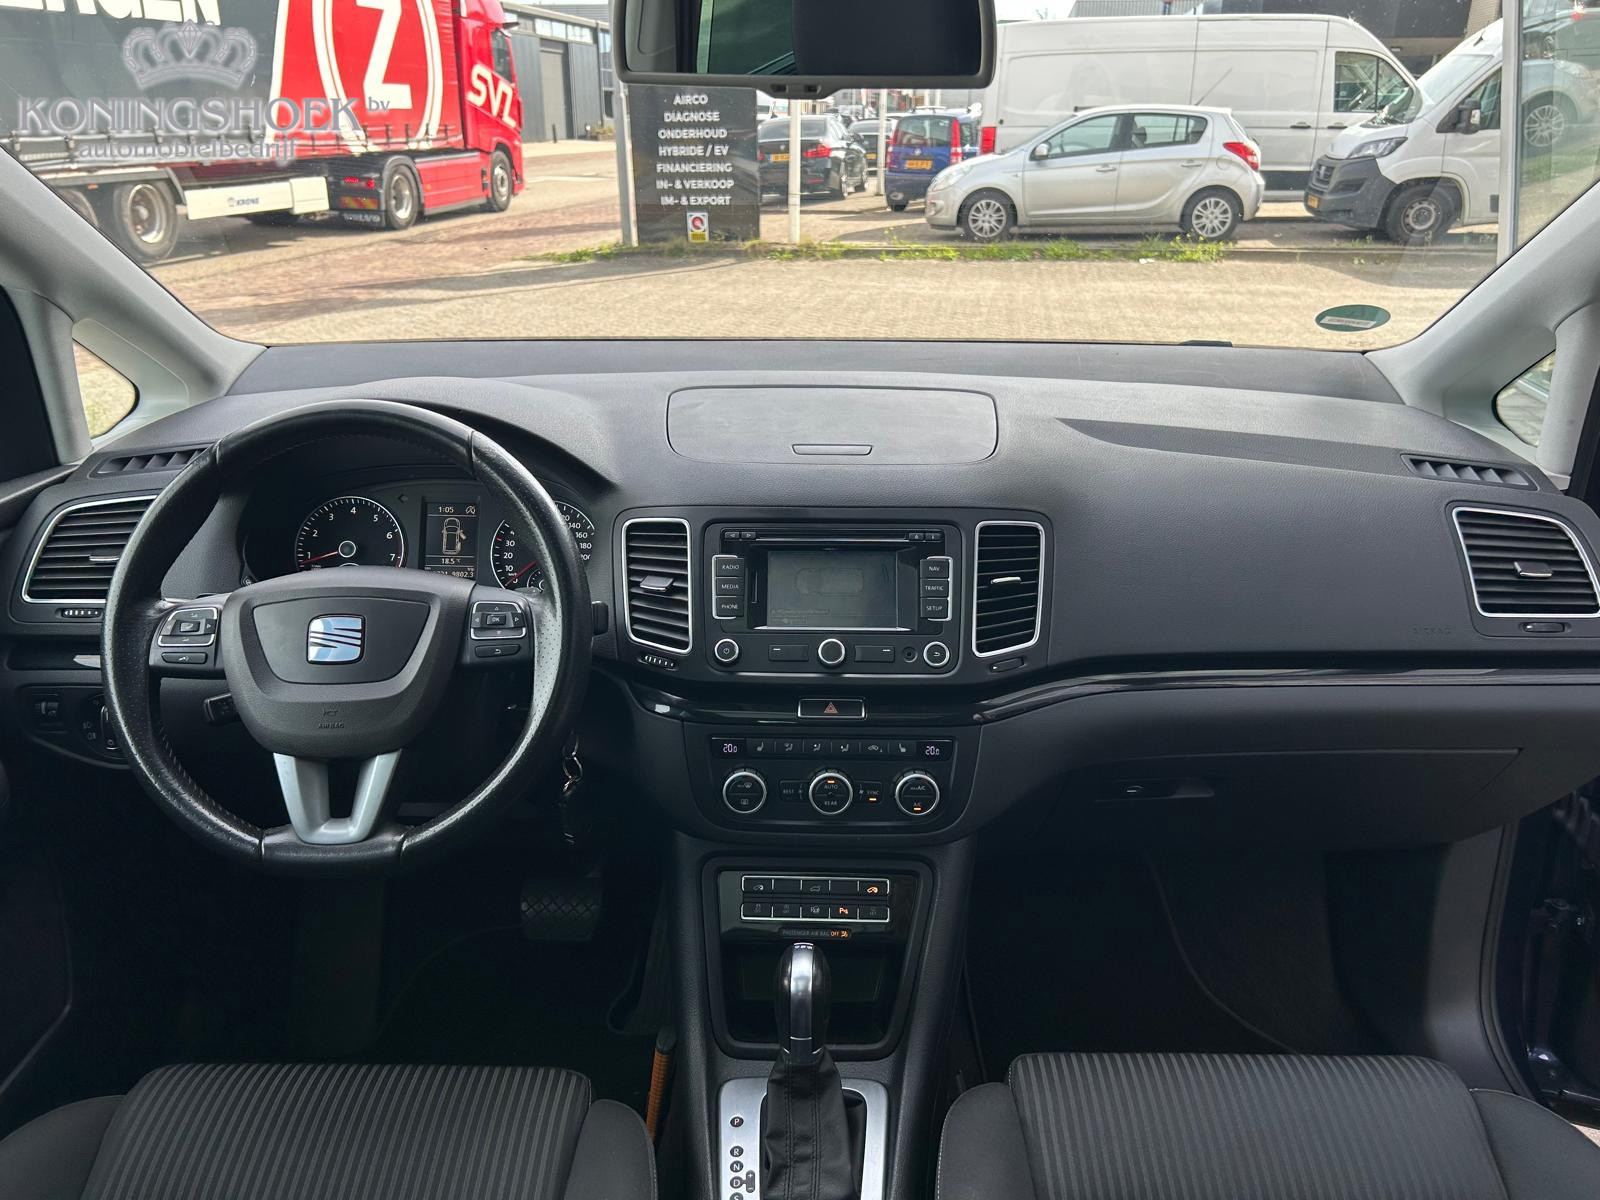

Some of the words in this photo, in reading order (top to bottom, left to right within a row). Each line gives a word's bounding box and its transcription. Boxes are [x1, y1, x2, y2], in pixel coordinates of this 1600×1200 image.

[467, 63, 517, 128] SVZ
[673, 94, 708, 105] AIRCO
[664, 112, 720, 122] DIAGNOSE
[658, 129, 727, 139] ONDERHOUD
[658, 146, 704, 156] HYBRIDE
[715, 145, 729, 156] EV
[656, 163, 733, 173] FINANCIERING
[656, 180, 673, 189] IN-
[674, 180, 683, 189] &
[684, 179, 735, 189] VERKOOP
[680, 196, 689, 205] &
[689, 195, 731, 205] EXPORT
[350, 506, 357, 514] 4
[389, 553, 396, 561] 7
[733, 1163, 740, 1171] N
[733, 1179, 740, 1187] D
